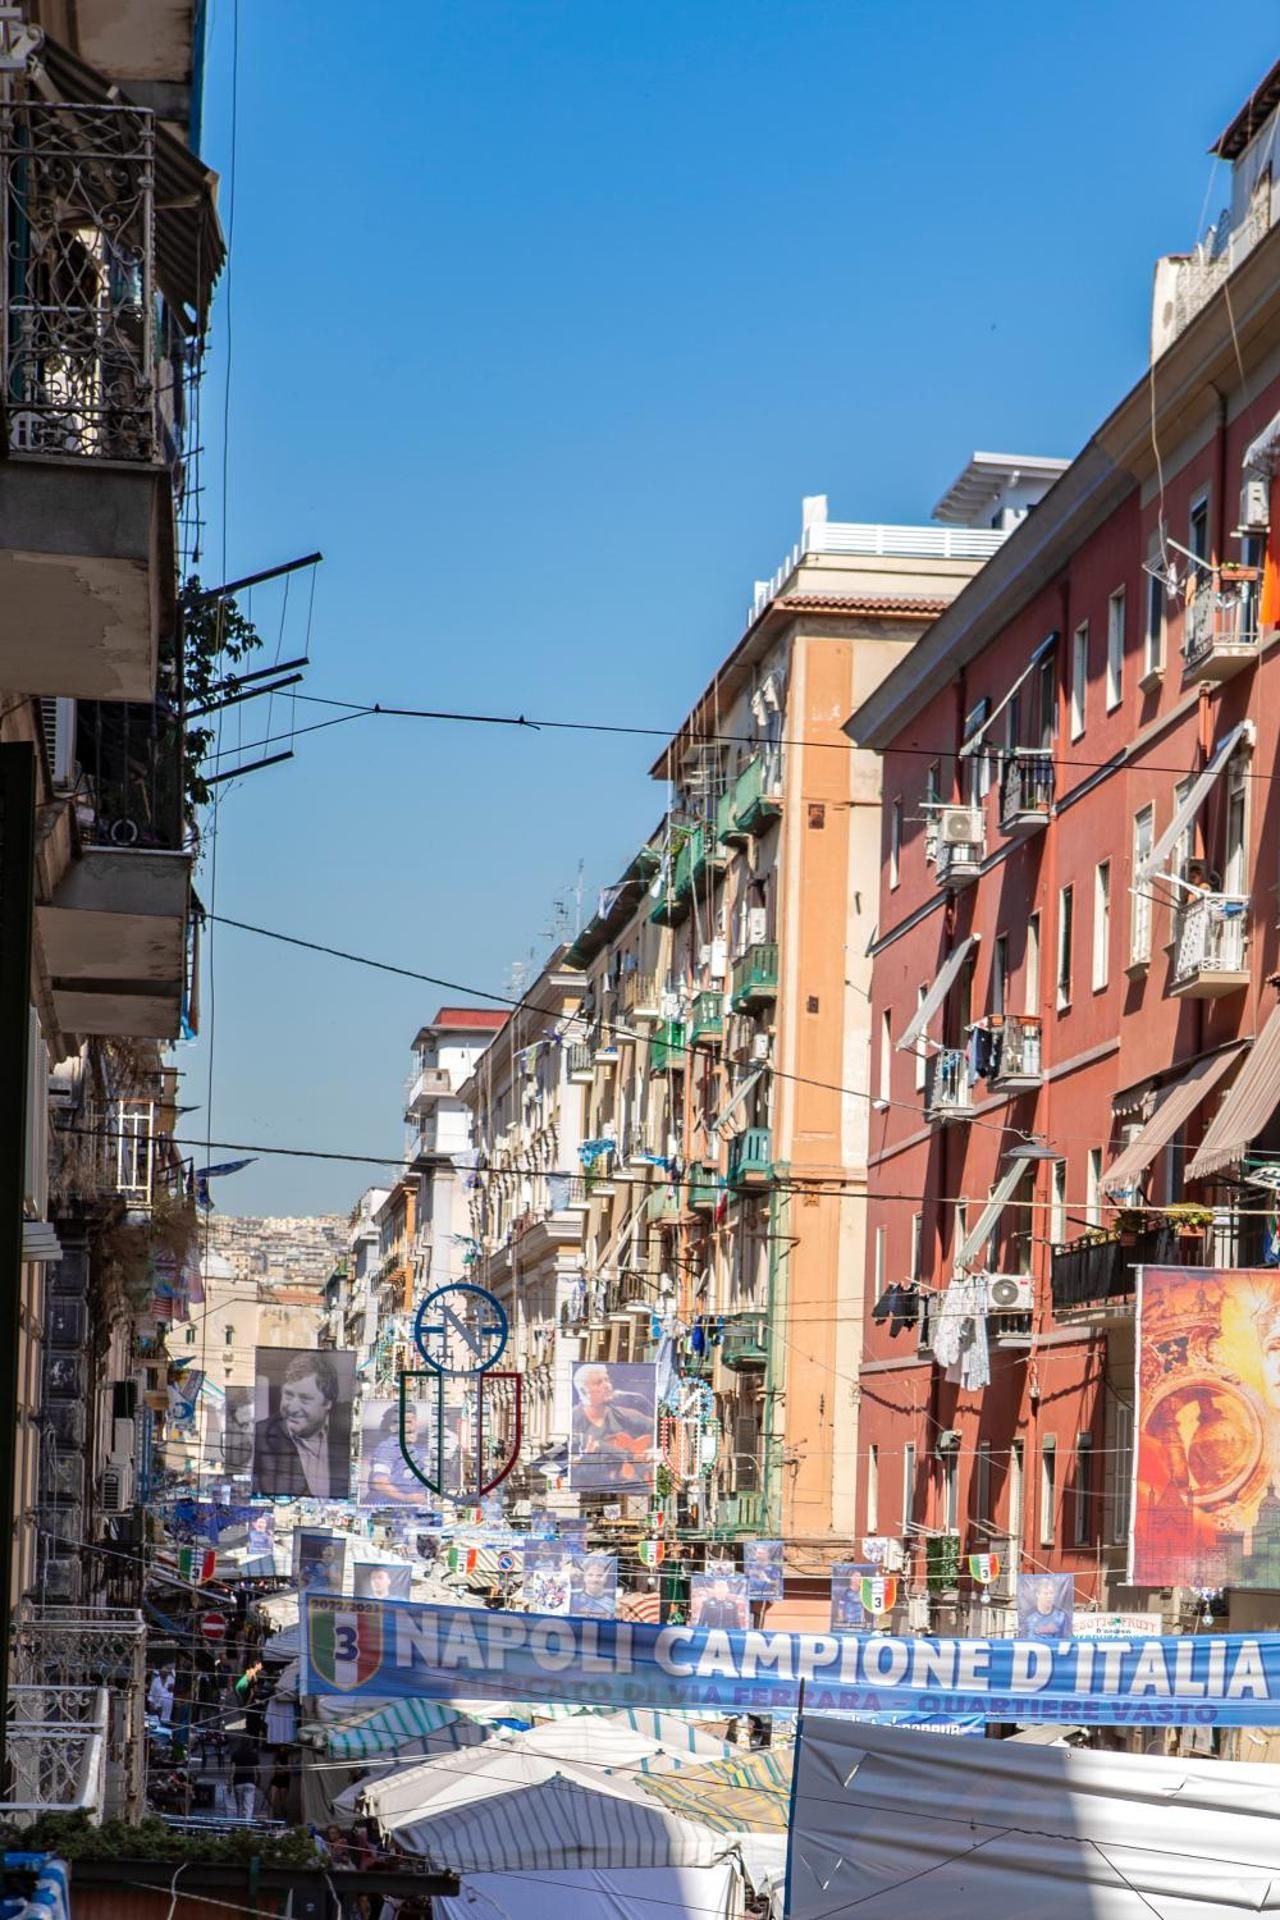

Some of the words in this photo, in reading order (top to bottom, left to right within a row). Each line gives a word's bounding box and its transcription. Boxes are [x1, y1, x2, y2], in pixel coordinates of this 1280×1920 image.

[874, 1597, 882, 1609] 3
[335, 1626, 358, 1661] 3
[395, 1608, 633, 1674] NAPOLI
[653, 1626, 992, 1692] CAMPIONE
[1010, 1640, 1270, 1699] D'ITALIA
[624, 1681, 658, 1703] DI
[667, 1684, 722, 1706] VIA
[733, 1687, 882, 1713] FERRARA
[917, 1694, 1099, 1722] QUARTIERE
[1110, 1703, 1219, 1724] VASTO
